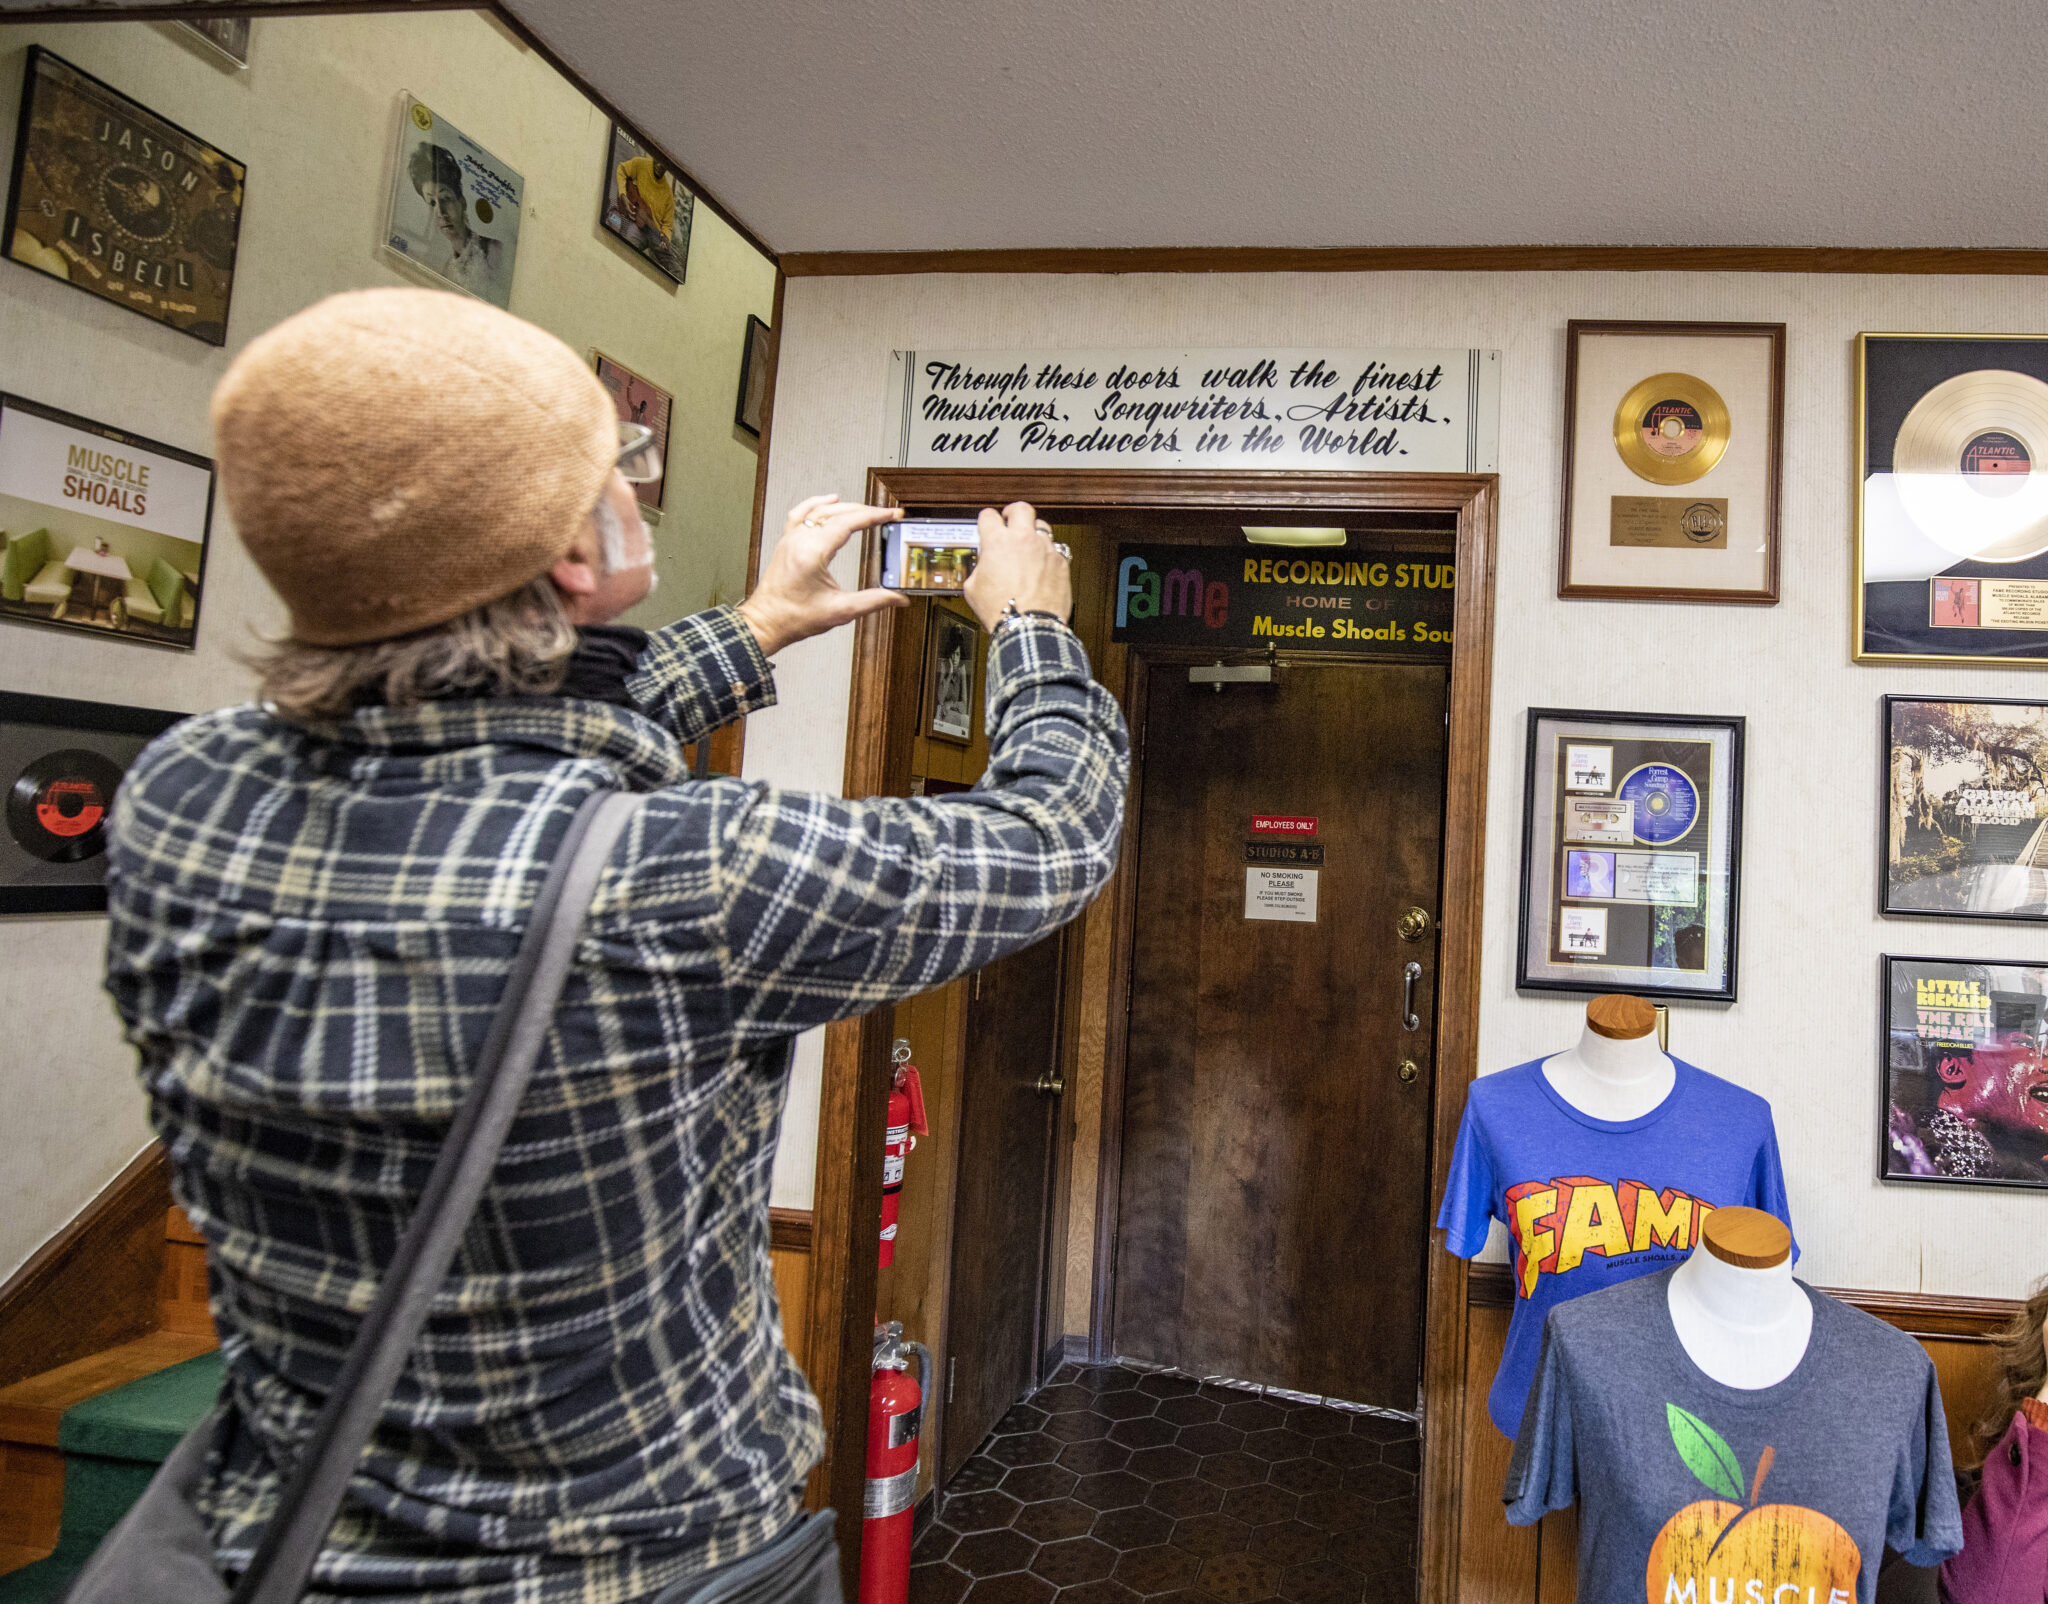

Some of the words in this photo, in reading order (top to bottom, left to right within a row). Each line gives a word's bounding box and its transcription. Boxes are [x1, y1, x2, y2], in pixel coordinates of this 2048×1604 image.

[616, 126, 637, 148] CARTER
[100, 121, 198, 191] JASON
[71, 216, 190, 287] ISBELL
[925, 361, 1030, 399] Through
[1035, 363, 1099, 390] these
[1106, 364, 1180, 390] doors
[1201, 359, 1278, 388] walk
[1290, 359, 1339, 389] the
[1352, 361, 1443, 397] finest
[922, 394, 1069, 422] Musicians,
[1094, 391, 1282, 432] Songwriters,
[1287, 391, 1451, 424] Artists,
[931, 426, 999, 452] and
[1020, 421, 1182, 452] Producers
[1195, 424, 1232, 453] in
[1241, 424, 1285, 453] the
[1299, 424, 1409, 456] World.
[67, 444, 150, 487] MUSCLE
[63, 475, 147, 515] SHOALS
[1244, 558, 1389, 587] RECORDING
[1395, 563, 1456, 589] STUD
[1115, 556, 1229, 628] fame
[1285, 596, 1352, 609] HOME
[1365, 599, 1395, 610] OF
[1252, 615, 1325, 638] Muscle
[1331, 618, 1406, 641] Shoals
[1412, 621, 1454, 643] Sou
[1963, 789, 2030, 801] GREGG
[1957, 798, 2036, 811] ALLMAN
[1255, 820, 1294, 829] EMPLOYEES
[1296, 821, 1314, 830] ONLY
[1971, 816, 2021, 826] BLOOD
[1247, 846, 1297, 858] STUDIOS
[1268, 880, 1295, 888] PLEASE
[1917, 978, 1980, 994] LITTLE
[1917, 1011, 1951, 1025] THE
[1917, 1025, 1974, 1040] THING
[1936, 1041, 1960, 1049] FREEDOM
[1606, 1256, 1640, 1269] MUSCLE
